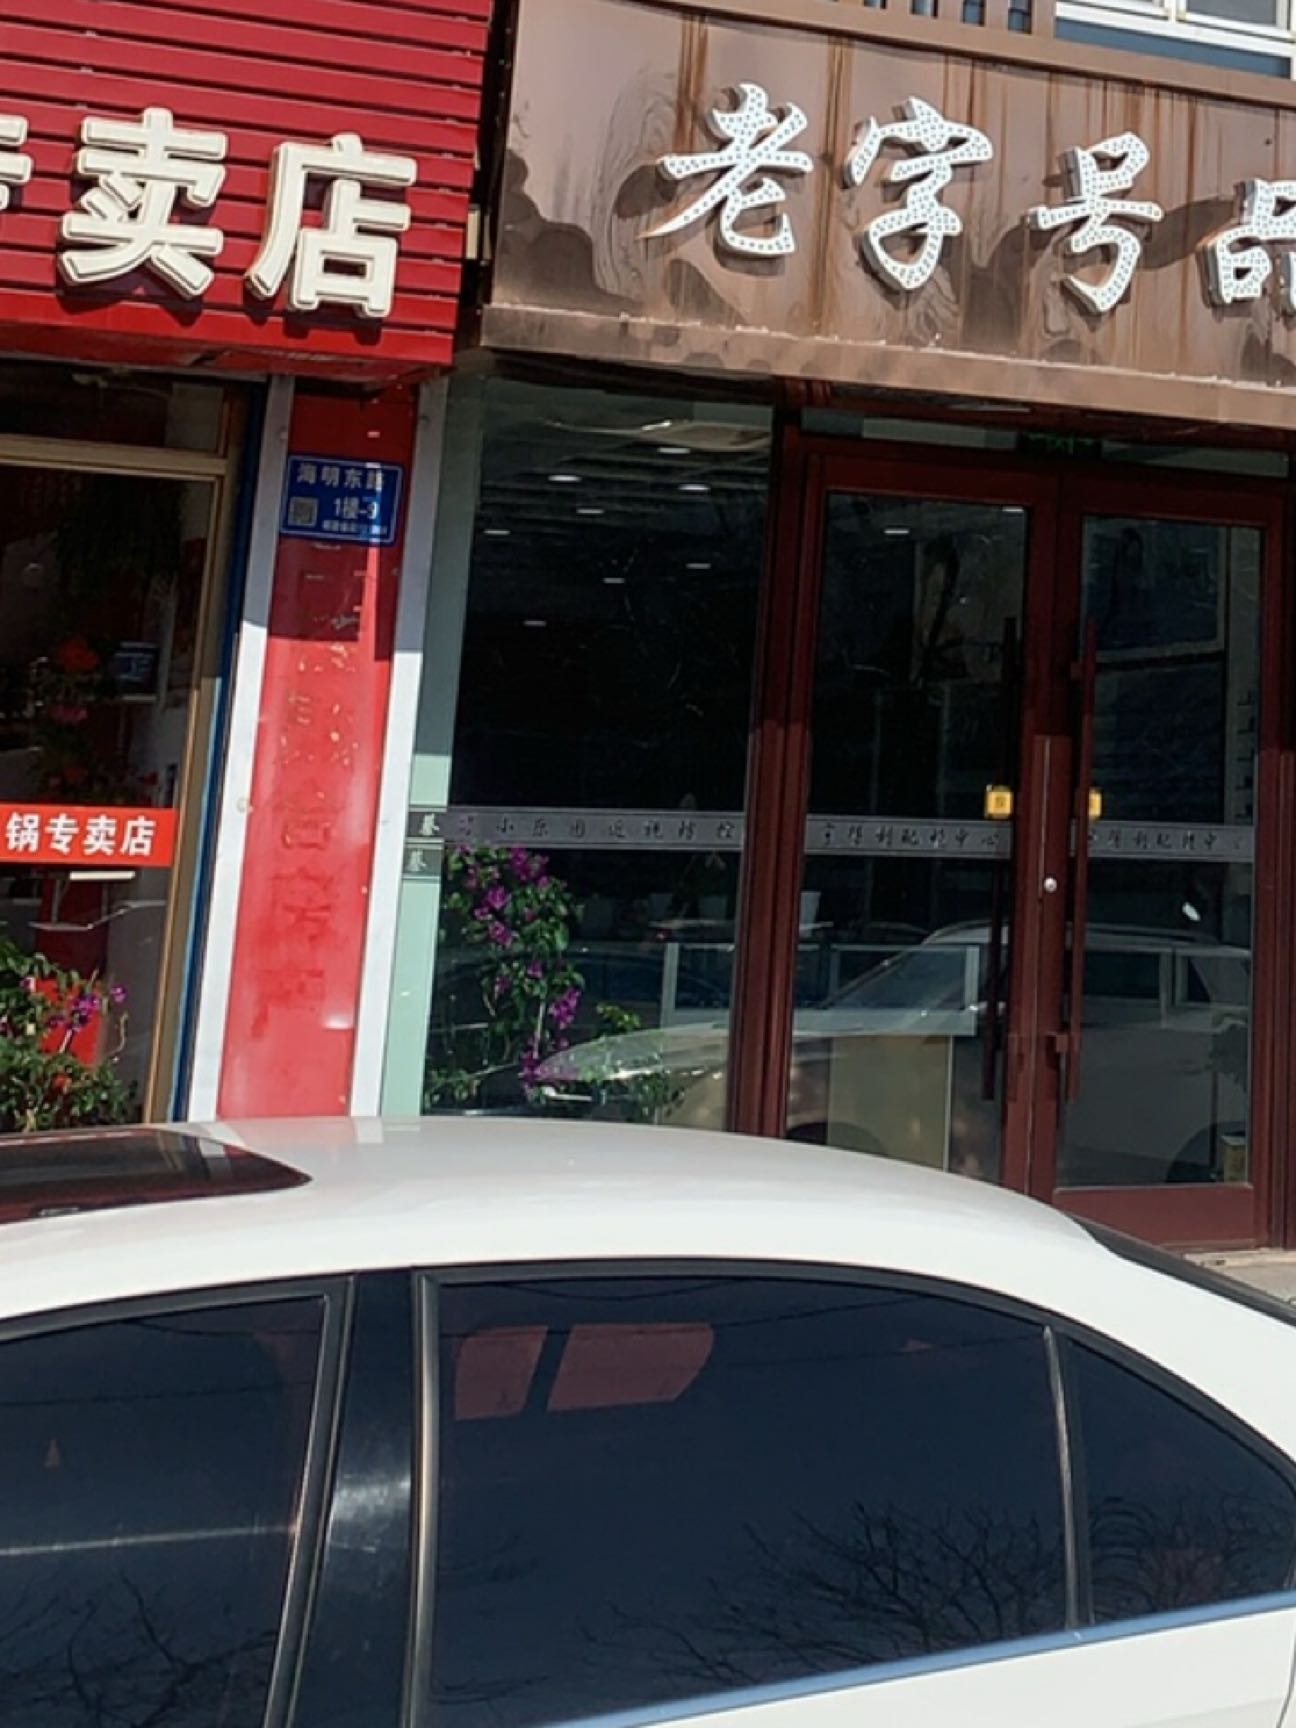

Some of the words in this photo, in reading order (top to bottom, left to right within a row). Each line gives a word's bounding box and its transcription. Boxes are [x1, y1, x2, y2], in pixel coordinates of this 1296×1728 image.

[0, 106, 418, 318] 卖店
[5, 811, 156, 857] 锅专卖店
